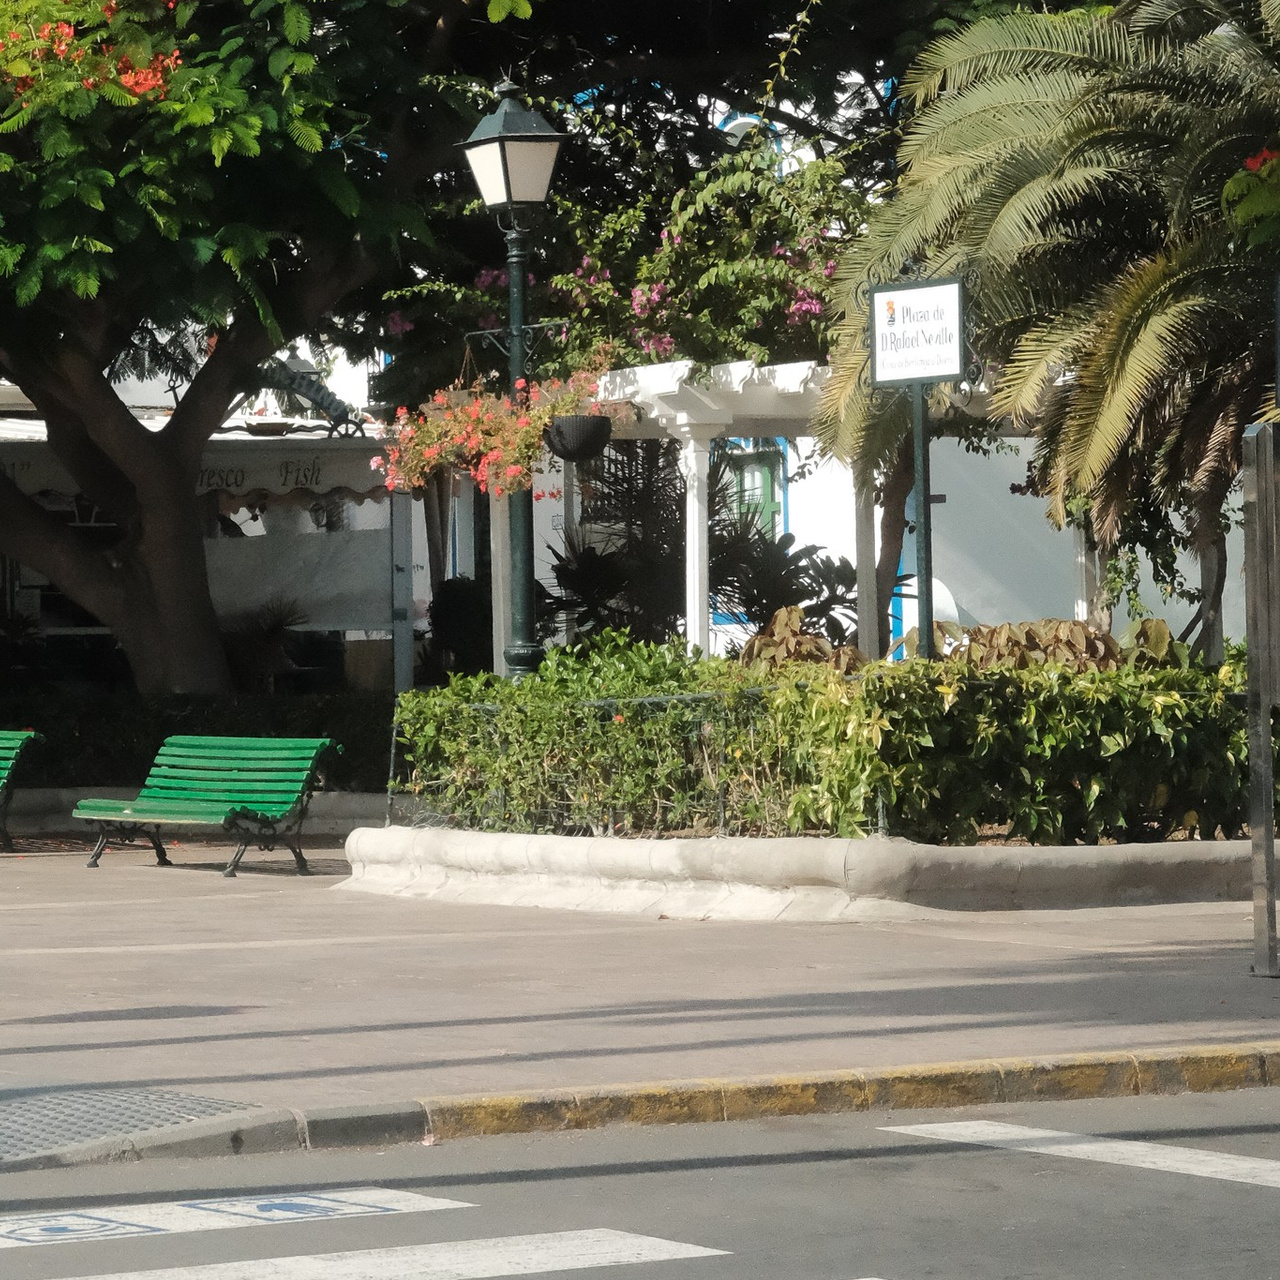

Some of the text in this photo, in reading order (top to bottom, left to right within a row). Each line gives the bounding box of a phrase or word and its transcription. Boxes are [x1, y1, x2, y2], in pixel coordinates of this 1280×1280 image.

[901, 304, 945, 324] Plaza de
[889, 330, 920, 352] Rafael
[198, 456, 322, 488] resco Fish
